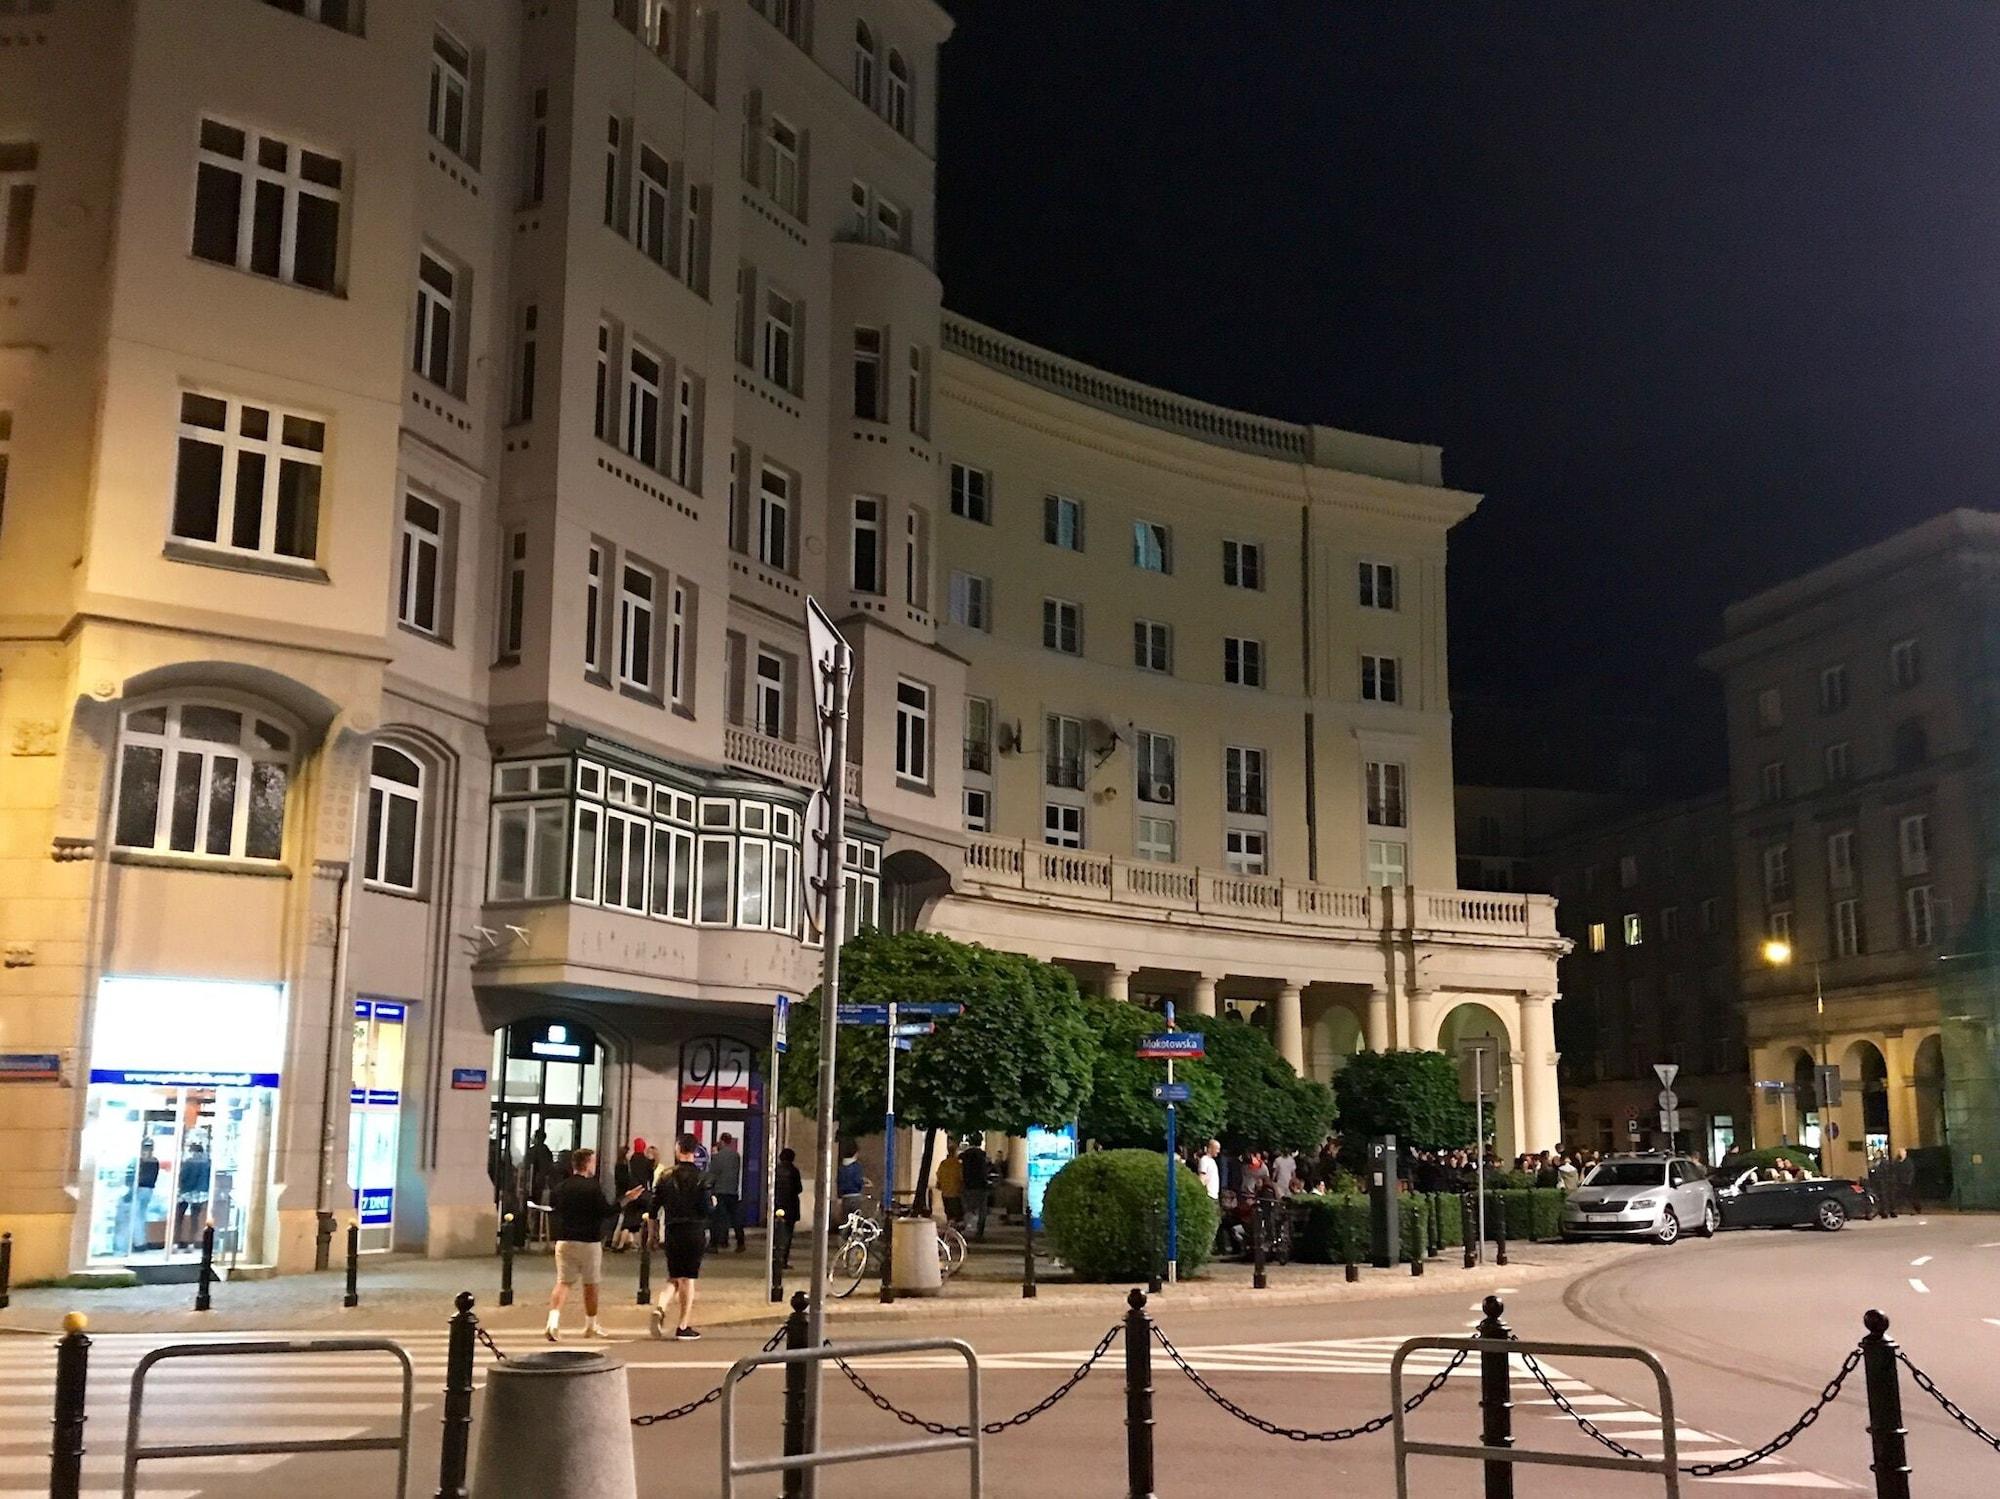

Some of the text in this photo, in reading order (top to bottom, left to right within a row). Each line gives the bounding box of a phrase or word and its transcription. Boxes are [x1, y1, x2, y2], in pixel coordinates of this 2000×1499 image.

[1143, 1039, 1197, 1049] Mokotowska
[1155, 1088, 1162, 1097] P
[1374, 1145, 1383, 1158] P
[362, 1196, 389, 1209] 7 DNI
